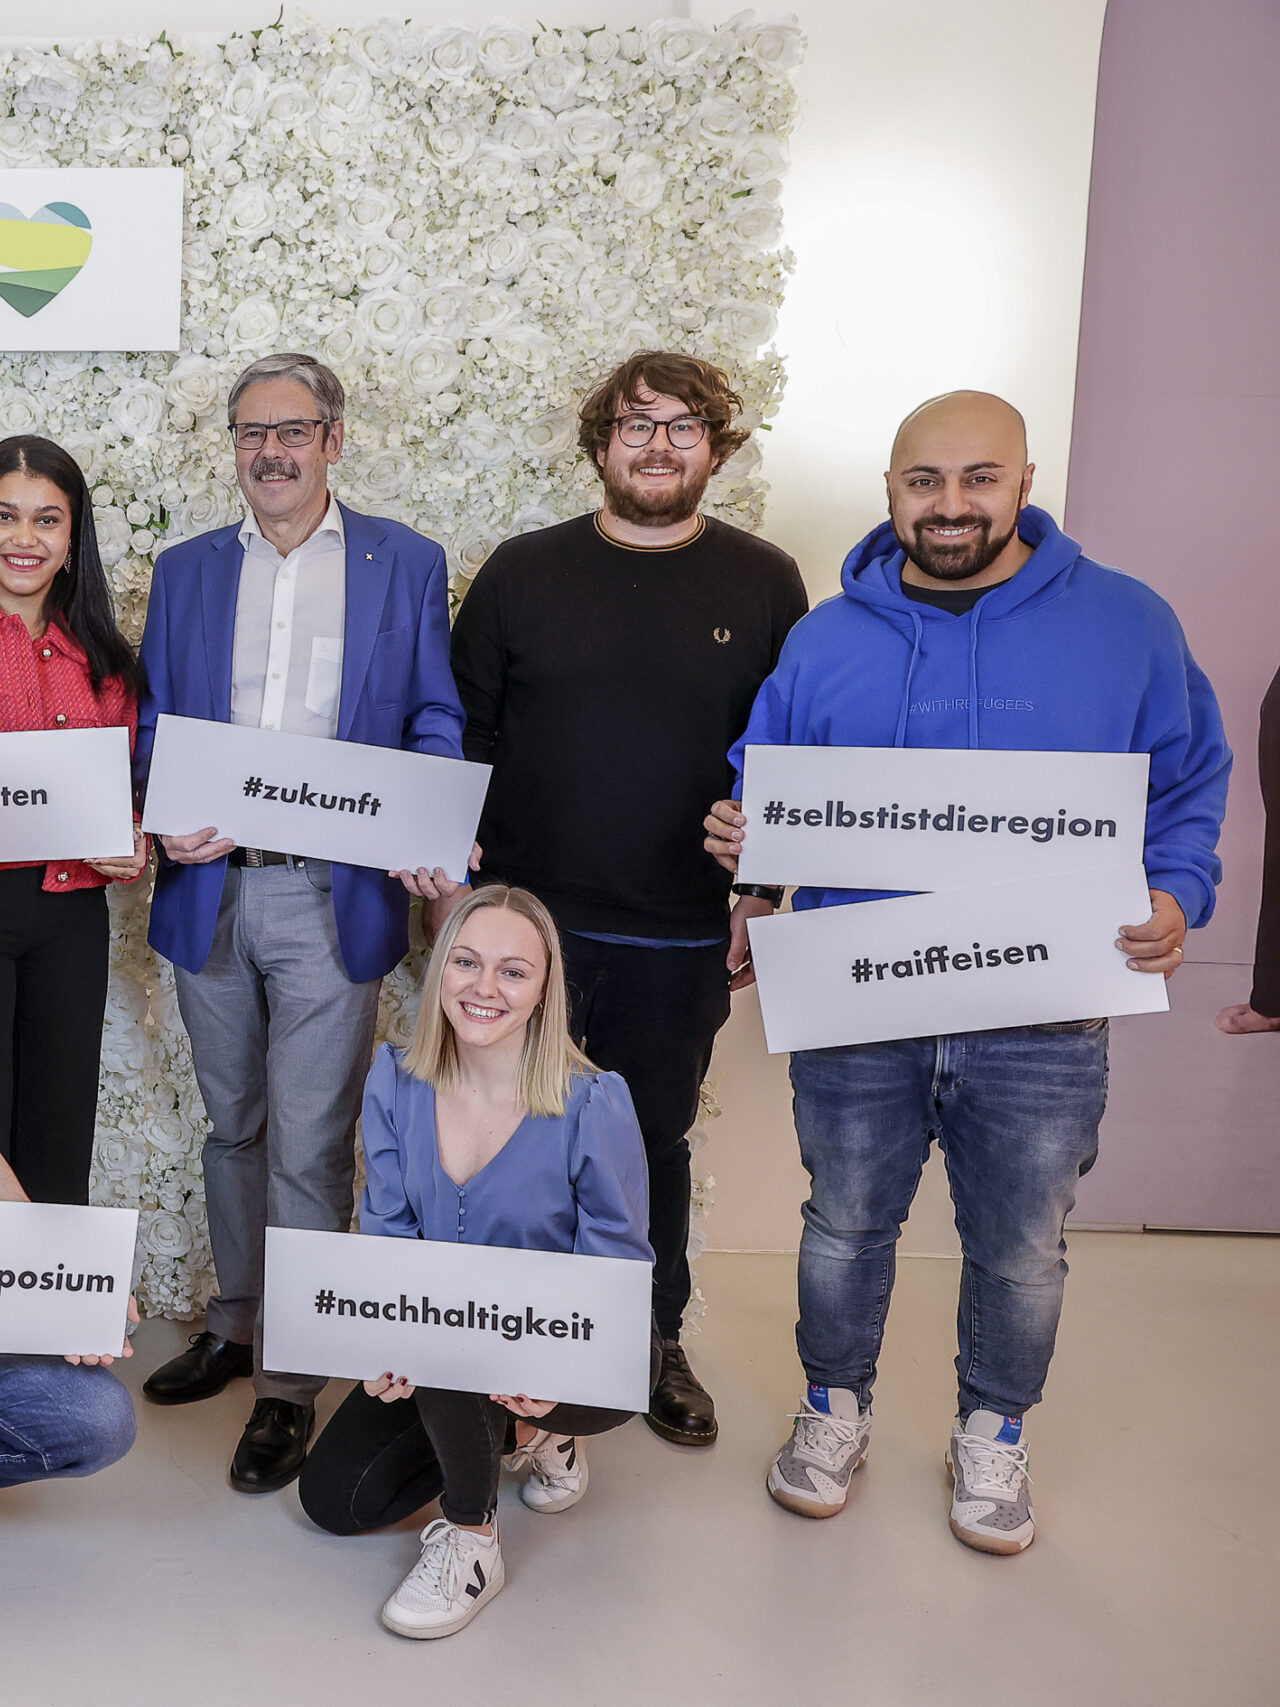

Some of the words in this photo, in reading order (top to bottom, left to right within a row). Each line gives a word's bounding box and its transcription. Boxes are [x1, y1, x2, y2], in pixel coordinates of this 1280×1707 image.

[242, 776, 382, 817] #zukunft
[762, 800, 1117, 843] #selbstistdieregion
[851, 942, 1049, 984] #raiffeisen
[314, 1289, 595, 1341] #nachhaltigkeit
